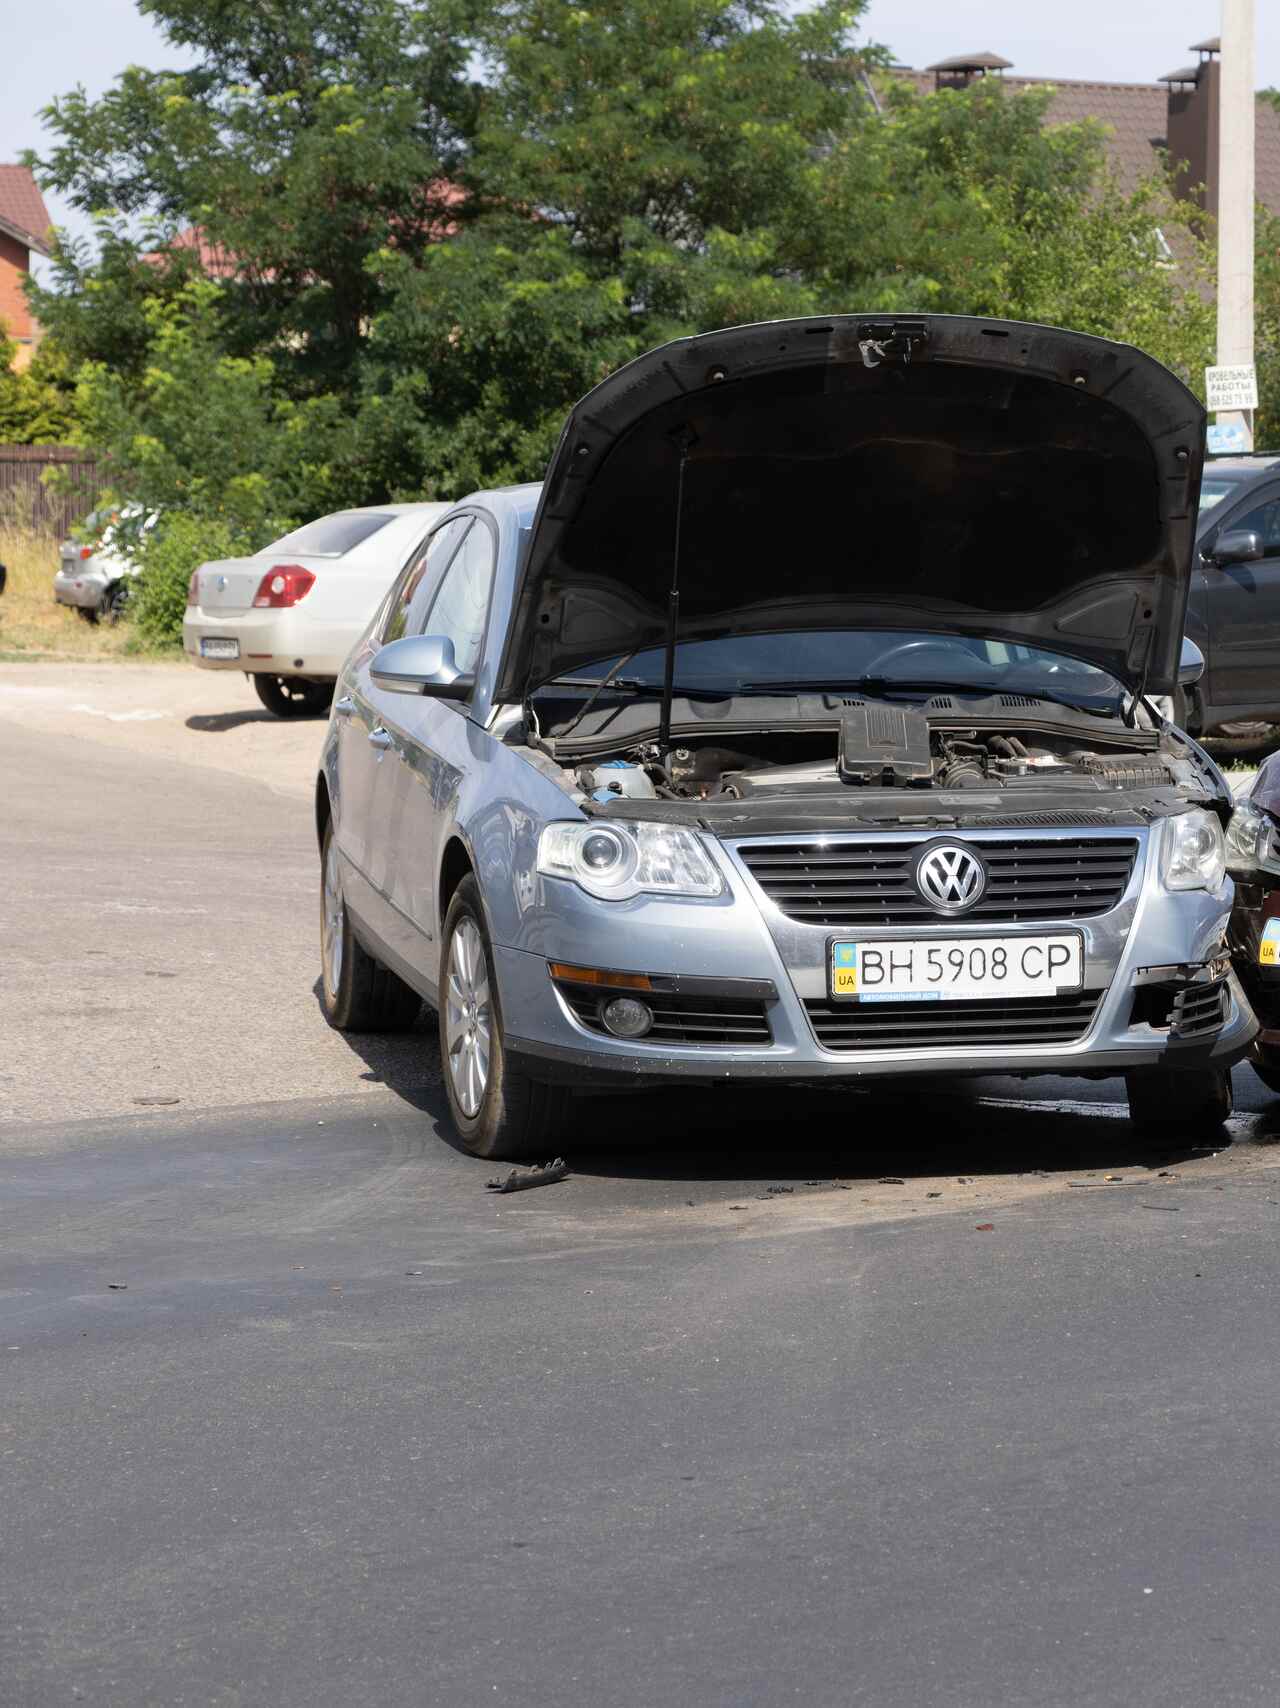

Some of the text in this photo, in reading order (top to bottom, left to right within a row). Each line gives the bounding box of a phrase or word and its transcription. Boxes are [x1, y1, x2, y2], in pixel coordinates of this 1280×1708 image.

[1211, 382, 1251, 392] РАБОТЫ
[1262, 947, 1274, 957] UA
[861, 944, 1071, 985] BH 5908 CP
[839, 975, 854, 986] UA
